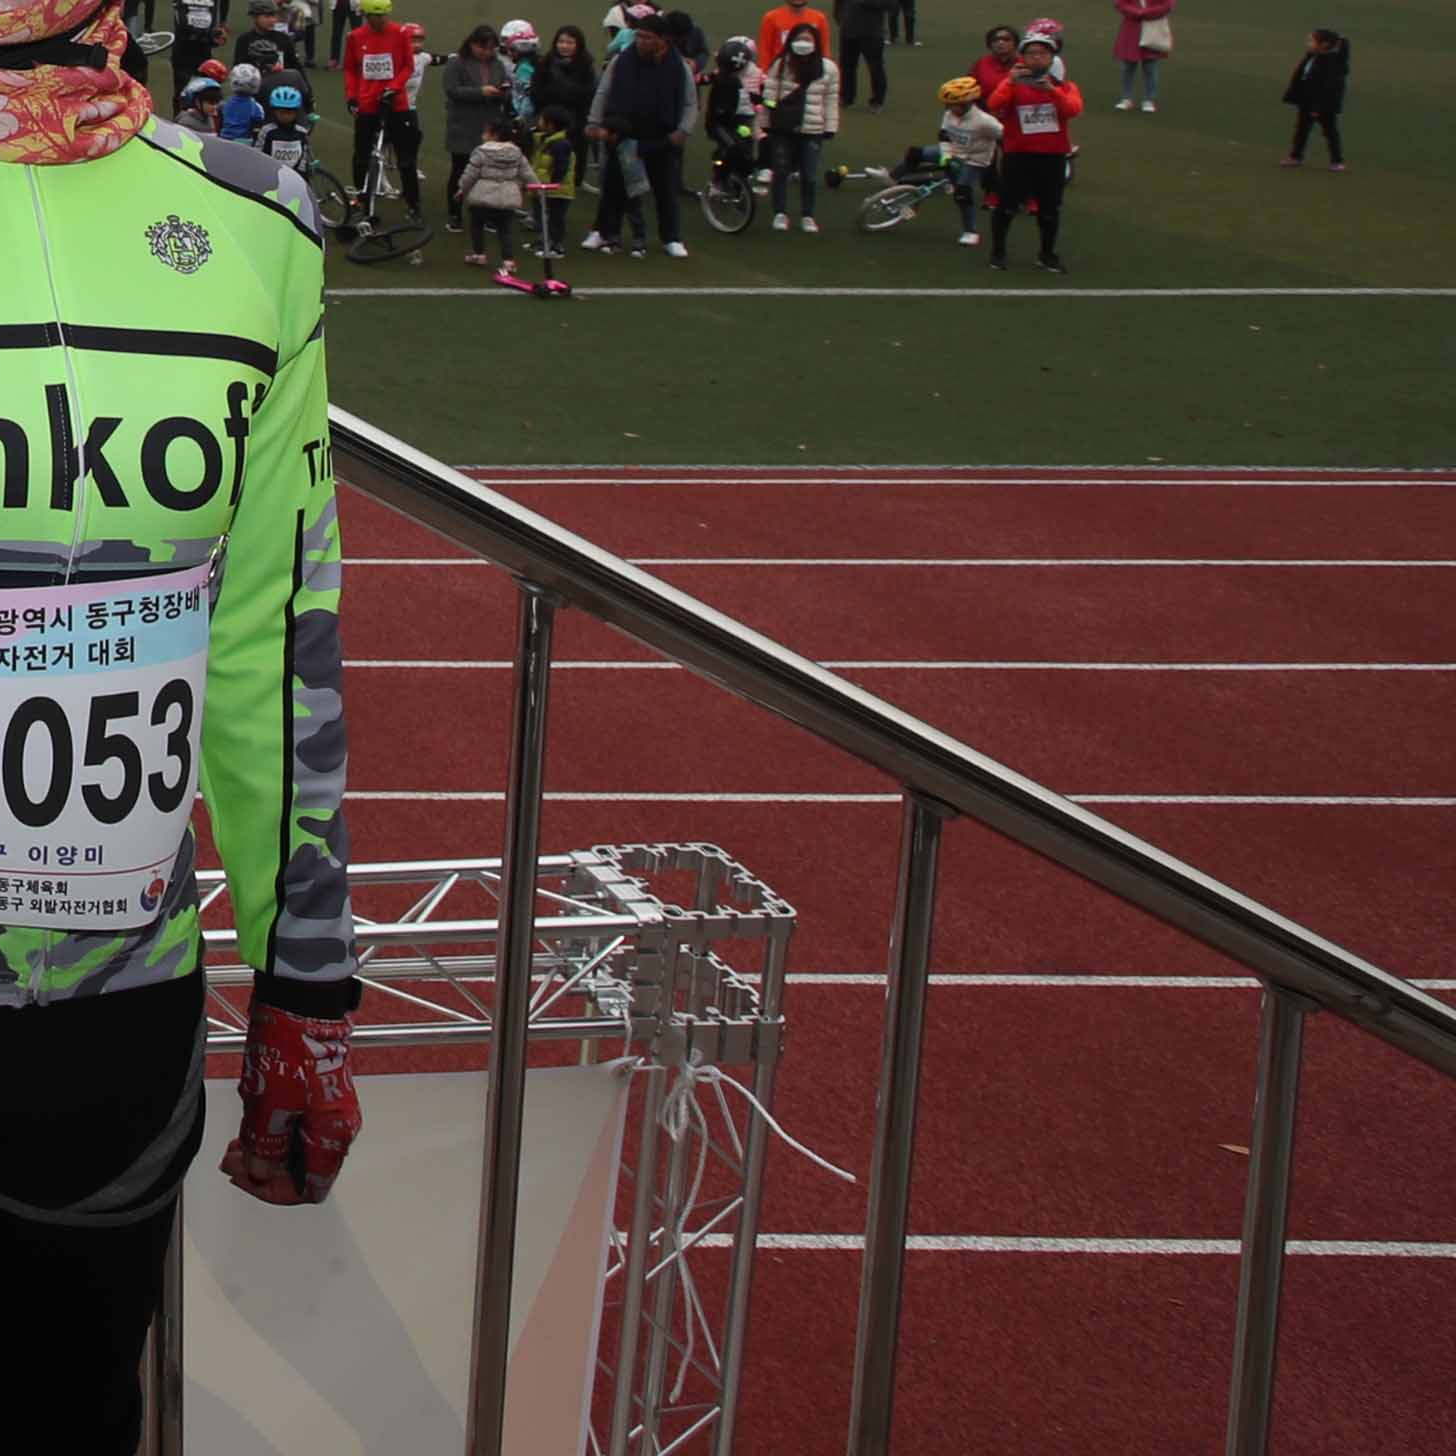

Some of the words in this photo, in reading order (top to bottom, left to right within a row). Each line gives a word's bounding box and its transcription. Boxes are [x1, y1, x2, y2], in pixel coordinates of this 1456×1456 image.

[85, 584, 201, 630] 동구청장배
[87, 636, 136, 666] 대회
[28, 896, 128, 915] 외발자전거협회
